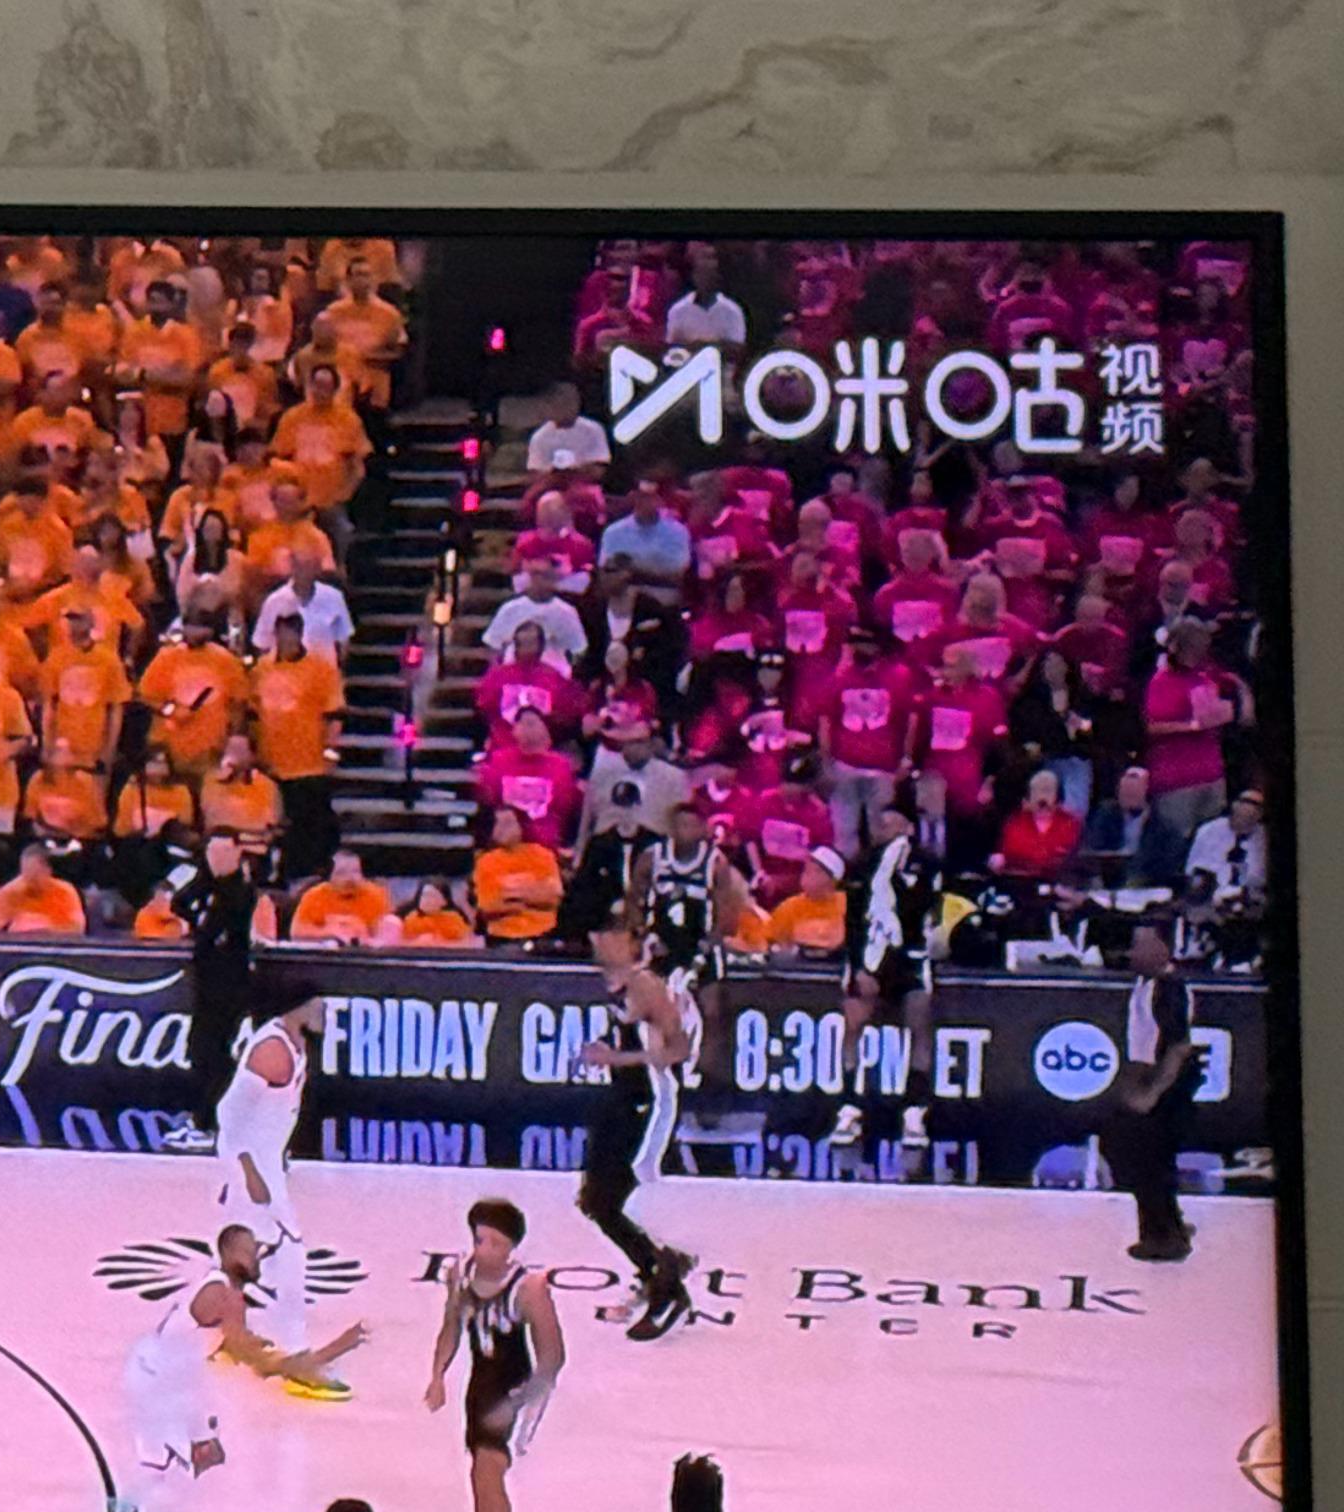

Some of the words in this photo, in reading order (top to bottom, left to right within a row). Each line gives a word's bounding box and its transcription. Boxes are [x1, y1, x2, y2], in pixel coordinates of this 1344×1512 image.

[743, 336, 1085, 456] 咪咕
[1099, 343, 1165, 456] 视频
[321, 997, 499, 1081] FRIDAY
[735, 1008, 845, 1094] 8:30
[934, 1026, 992, 1098] ET
[1041, 1038, 1112, 1073] abc
[792, 1266, 1148, 1318] Bank
